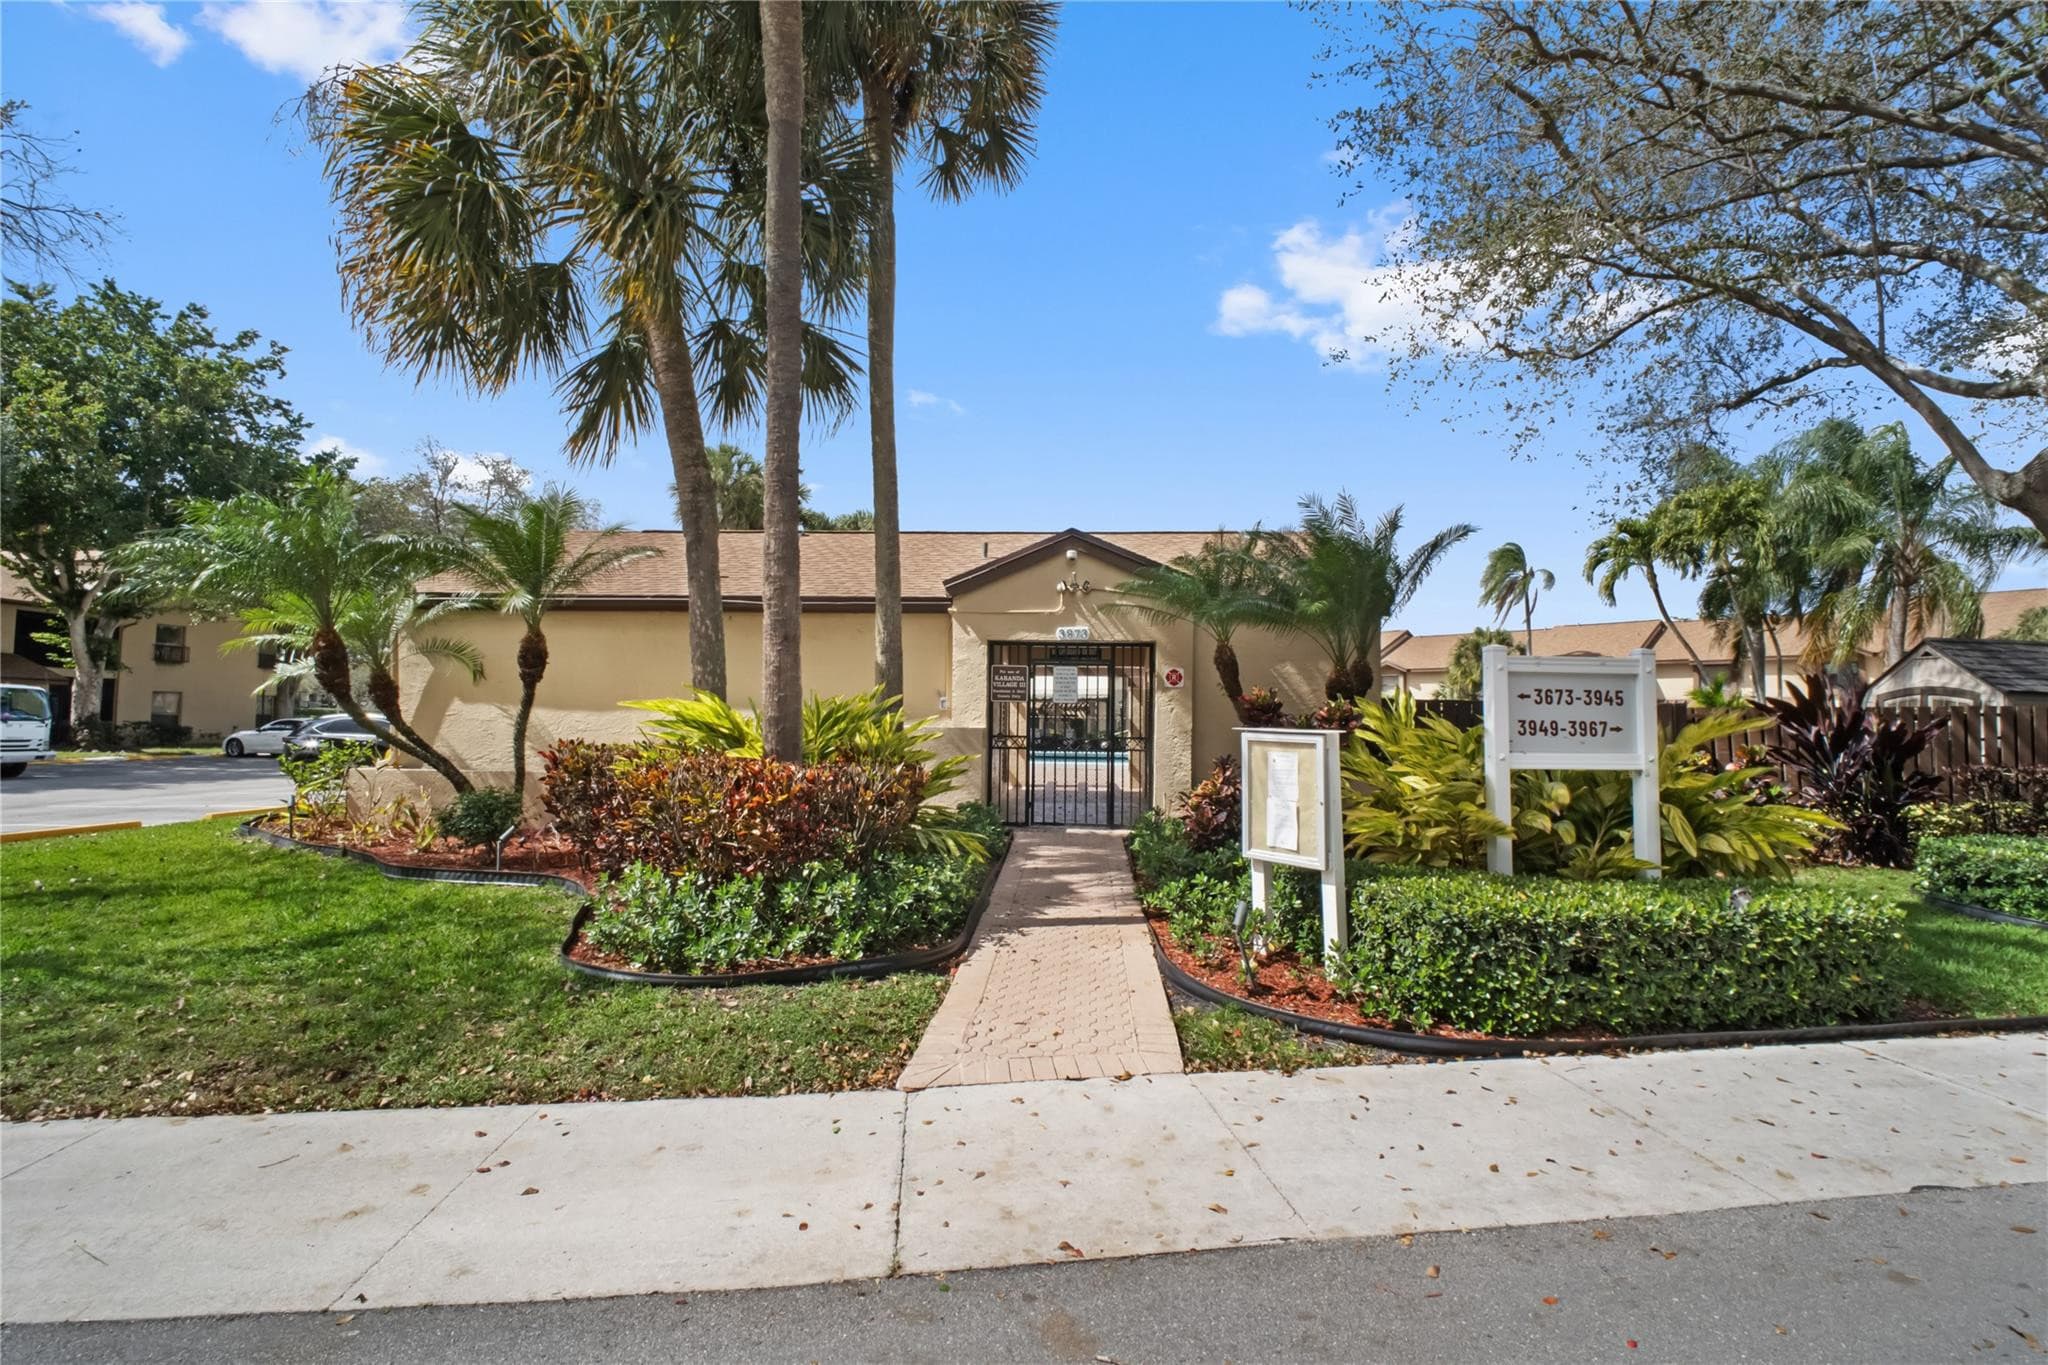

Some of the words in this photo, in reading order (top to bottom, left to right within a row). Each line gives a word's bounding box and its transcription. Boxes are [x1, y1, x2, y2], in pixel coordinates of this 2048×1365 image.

[1059, 628, 1088, 640] 3873
[1533, 688, 1624, 706] 3673-3945
[1517, 719, 1608, 737] 3949-3967
